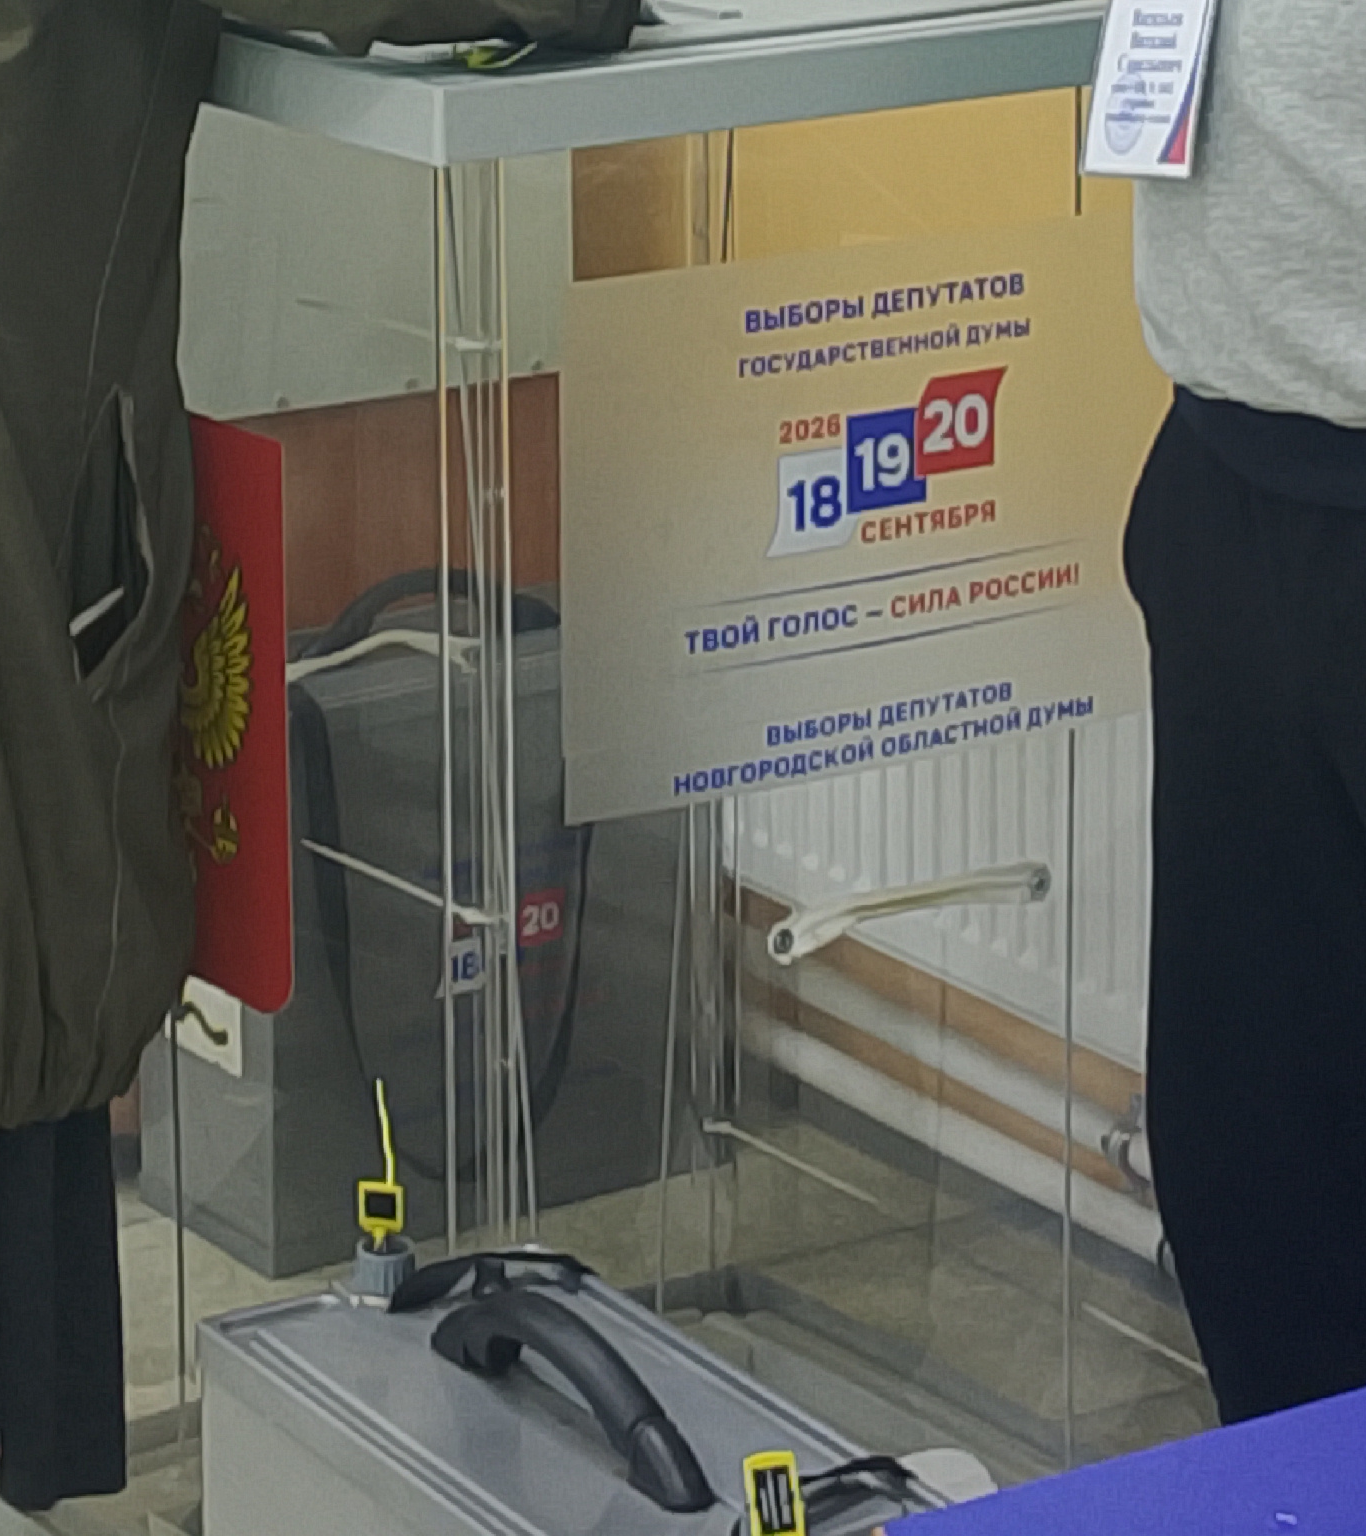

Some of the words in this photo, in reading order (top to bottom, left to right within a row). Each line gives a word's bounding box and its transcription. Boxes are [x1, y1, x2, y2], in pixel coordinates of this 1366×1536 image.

[744, 295, 864, 334] ВЫБОРЫ
[870, 272, 1025, 319] ДЕПУТАТОВ
[738, 323, 961, 378] ГОСУДАРСТВЕННОЙ
[965, 317, 1031, 348] ДУМЫ
[779, 414, 841, 444] 2026
[786, 475, 842, 532] 18
[854, 432, 910, 492] 19
[922, 393, 989, 455] 20
[860, 500, 997, 544] СЕНТЯБРЯ
[685, 614, 760, 655] ТВОЙ
[767, 604, 858, 642] ГОЛОС
[890, 587, 962, 620] СИЛА
[969, 562, 1080, 604] РОССИИ!
[766, 708, 872, 747] ВЫБОРЫ
[878, 682, 1013, 730] ДЕПУТАТОВ
[673, 735, 874, 796] НОВГОРОДСКОЙ
[881, 706, 1022, 758] ОБЛАСТНОЙ
[1026, 696, 1094, 733] ДУМЫ
[520, 900, 560, 937] 20
